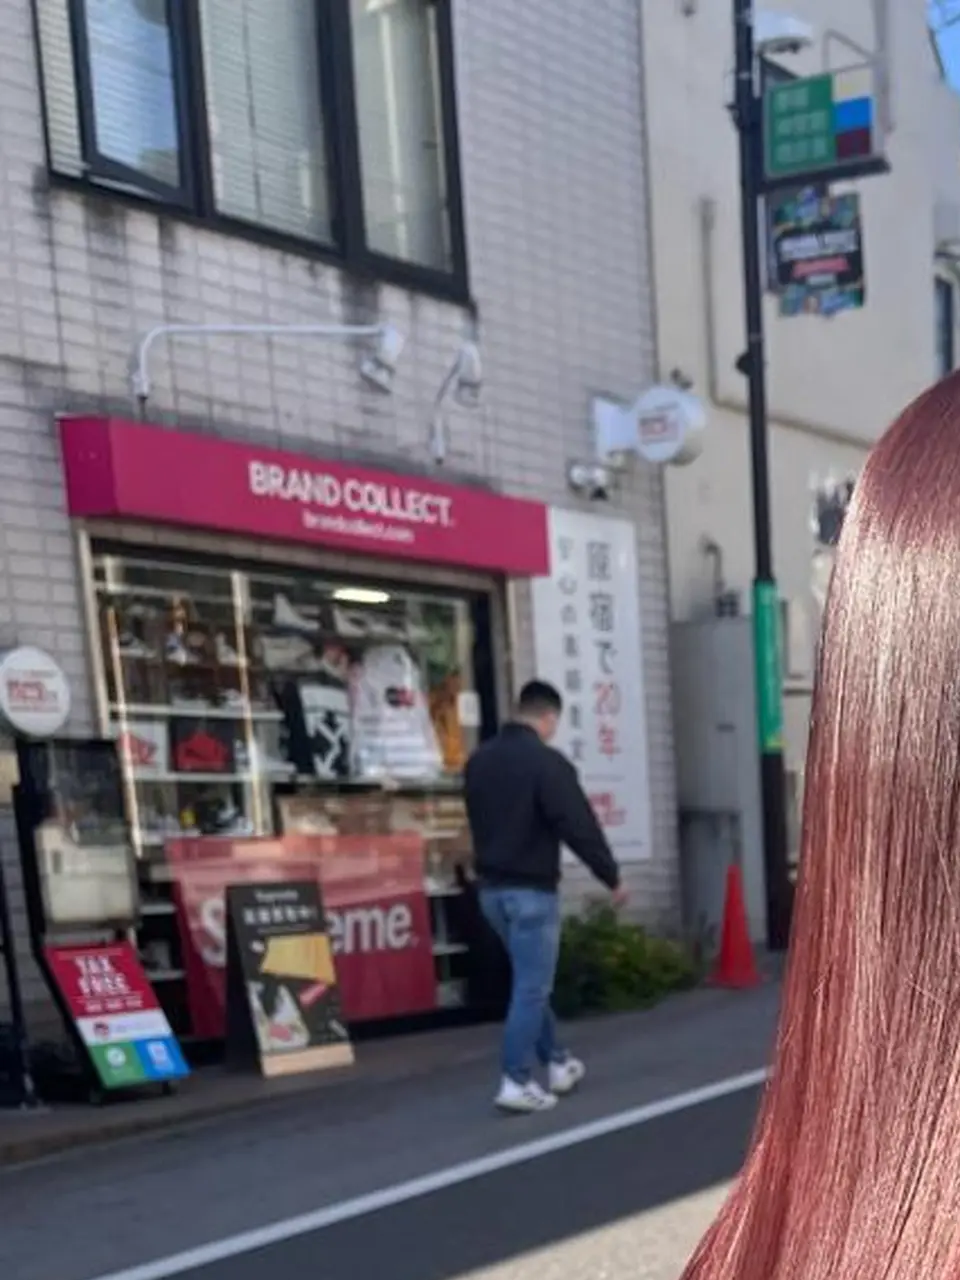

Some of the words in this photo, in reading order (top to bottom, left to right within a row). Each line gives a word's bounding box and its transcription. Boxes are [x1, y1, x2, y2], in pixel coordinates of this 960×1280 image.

[249, 460, 341, 508] BRAND
[201, 898, 413, 968] Seme
[74, 954, 117, 976] TAX
[78, 972, 131, 997] FREE
